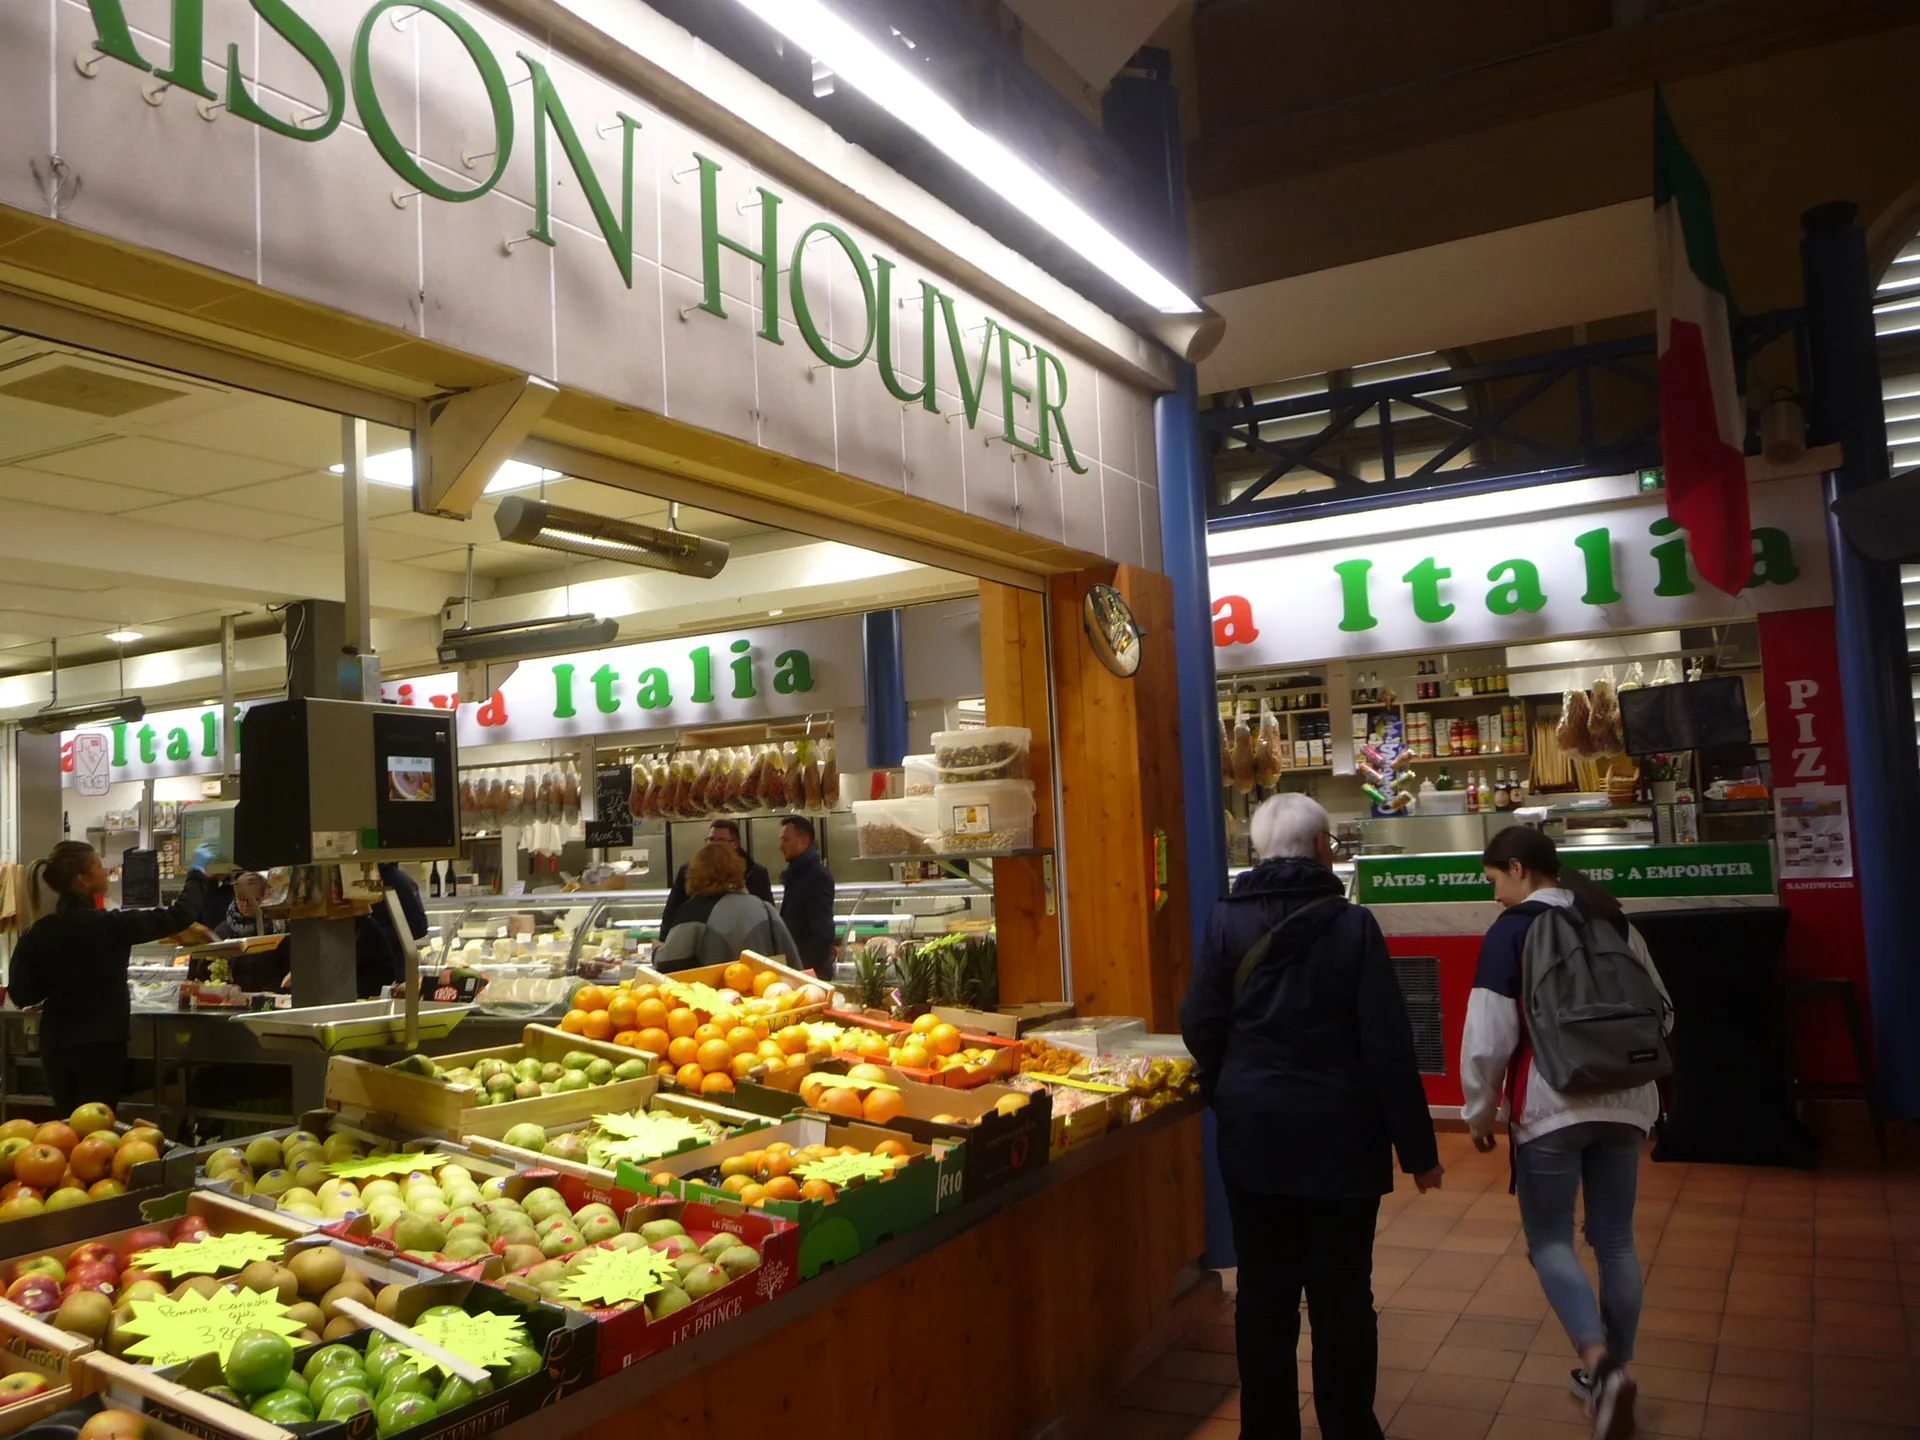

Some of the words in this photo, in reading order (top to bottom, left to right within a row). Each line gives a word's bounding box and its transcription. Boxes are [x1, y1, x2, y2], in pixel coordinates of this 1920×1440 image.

[692, 151, 1089, 475] HOUVER
[1333, 516, 1800, 633] Italia
[552, 639, 815, 718] Italia
[1785, 679, 1827, 788] PIZ
[77, 773, 110, 791] TICKET
[1372, 871, 1427, 887] PÂTES
[1627, 867, 1642, 880] A
[1645, 862, 1754, 879] EMPORTER
[434, 986, 458, 1001] TROPS
[695, 1295, 742, 1336] PRINCE
